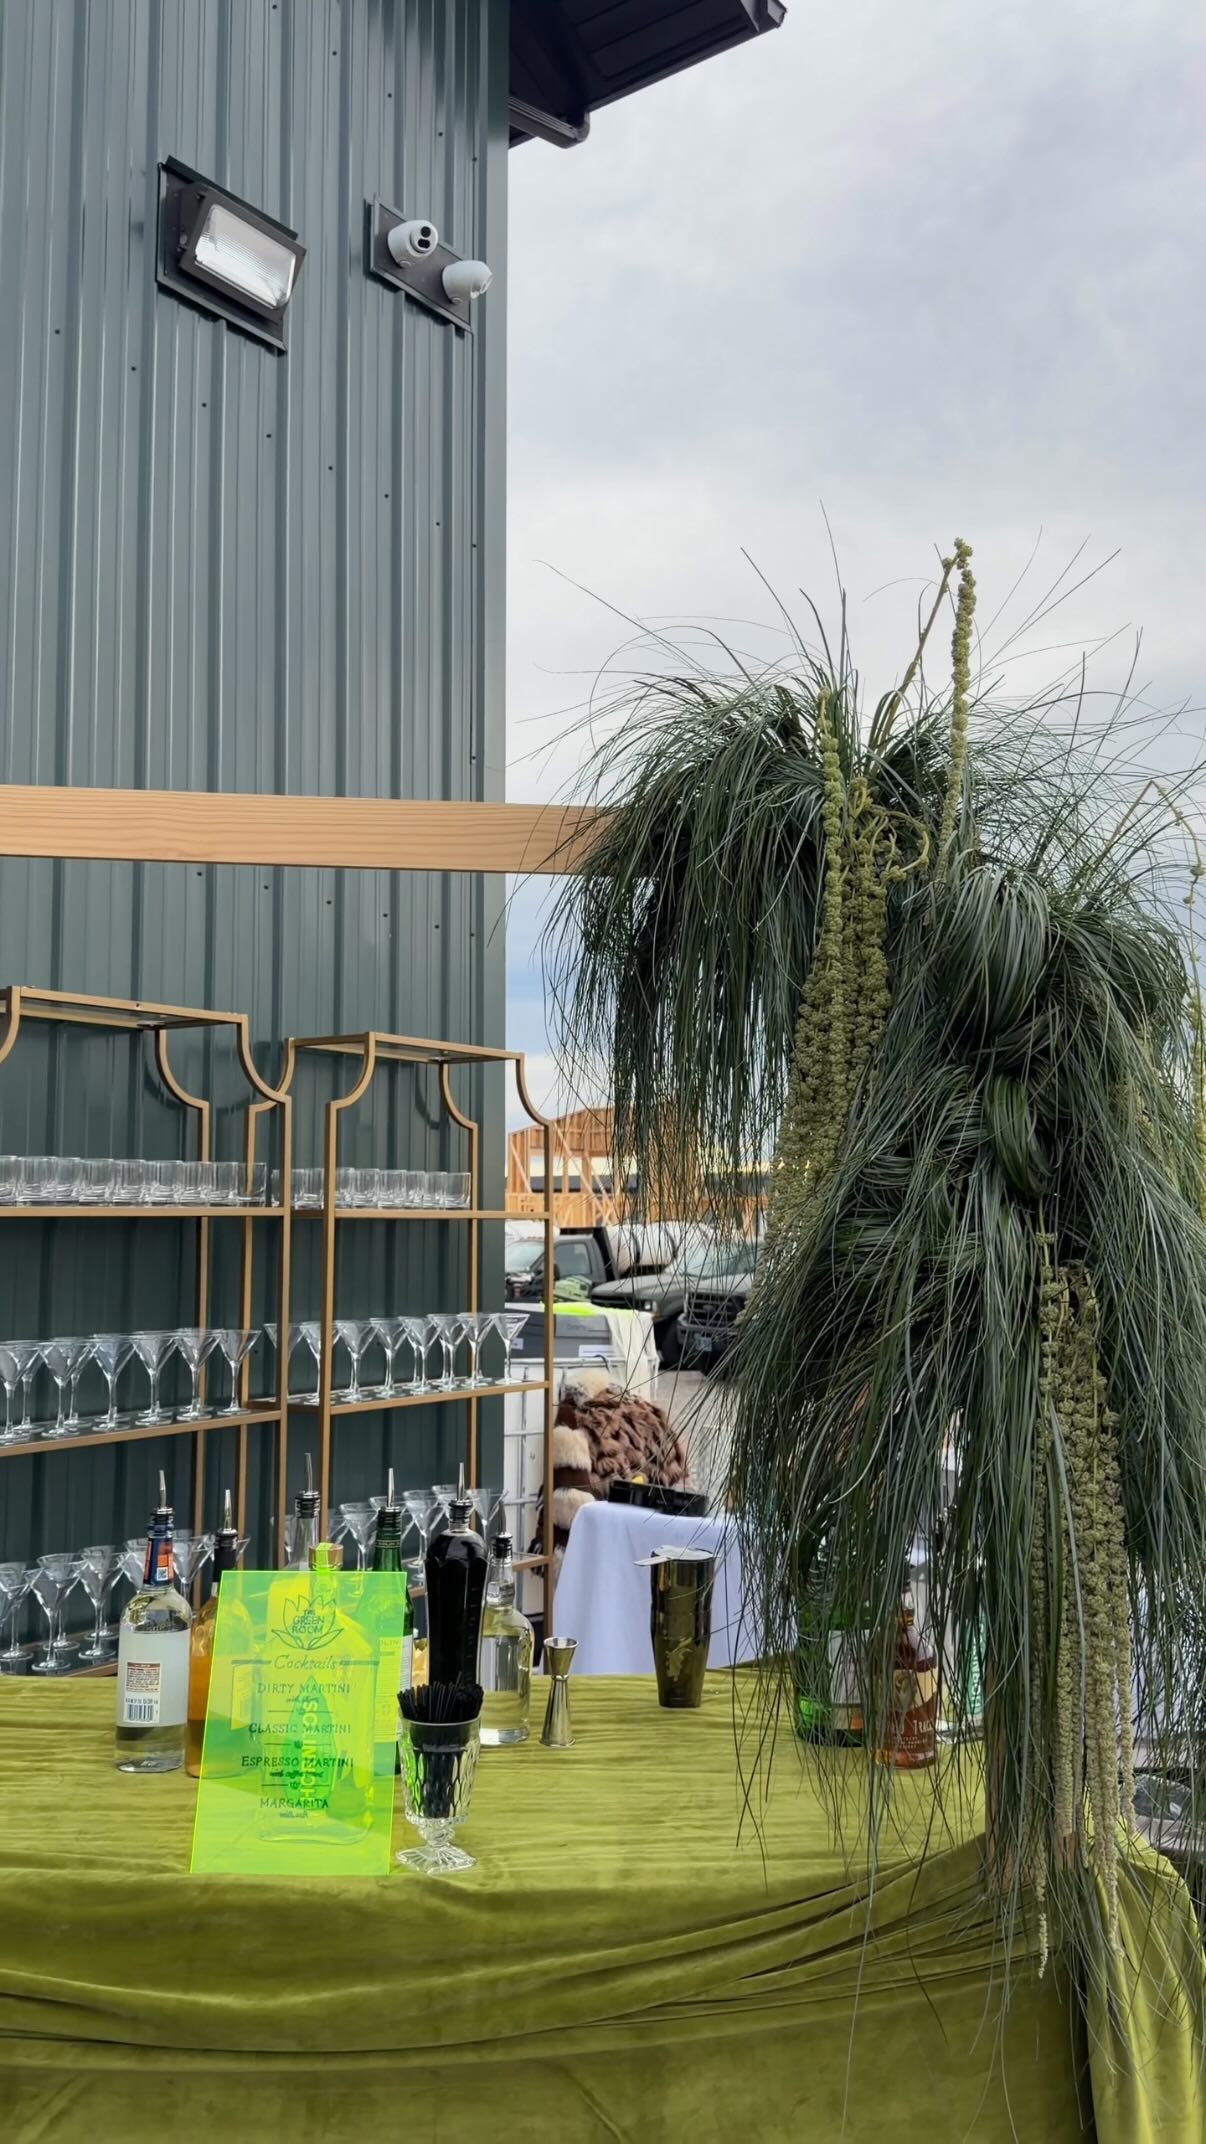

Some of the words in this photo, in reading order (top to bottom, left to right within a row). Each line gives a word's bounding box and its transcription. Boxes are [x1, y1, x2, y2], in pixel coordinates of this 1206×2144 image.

[293, 1616, 324, 1625] GREEN
[292, 1625, 323, 1634] ROOM
[274, 1654, 336, 1670] Cocktails
[257, 1683, 294, 1694] DIRTY
[299, 1683, 350, 1694] MARTINI
[248, 1723, 298, 1734] CLASSIC
[302, 1724, 351, 1734] MARTINI
[241, 1756, 299, 1767] ESPRESSO
[303, 1757, 354, 1768] MARTINI
[260, 1798, 329, 1809] MARGARITA
